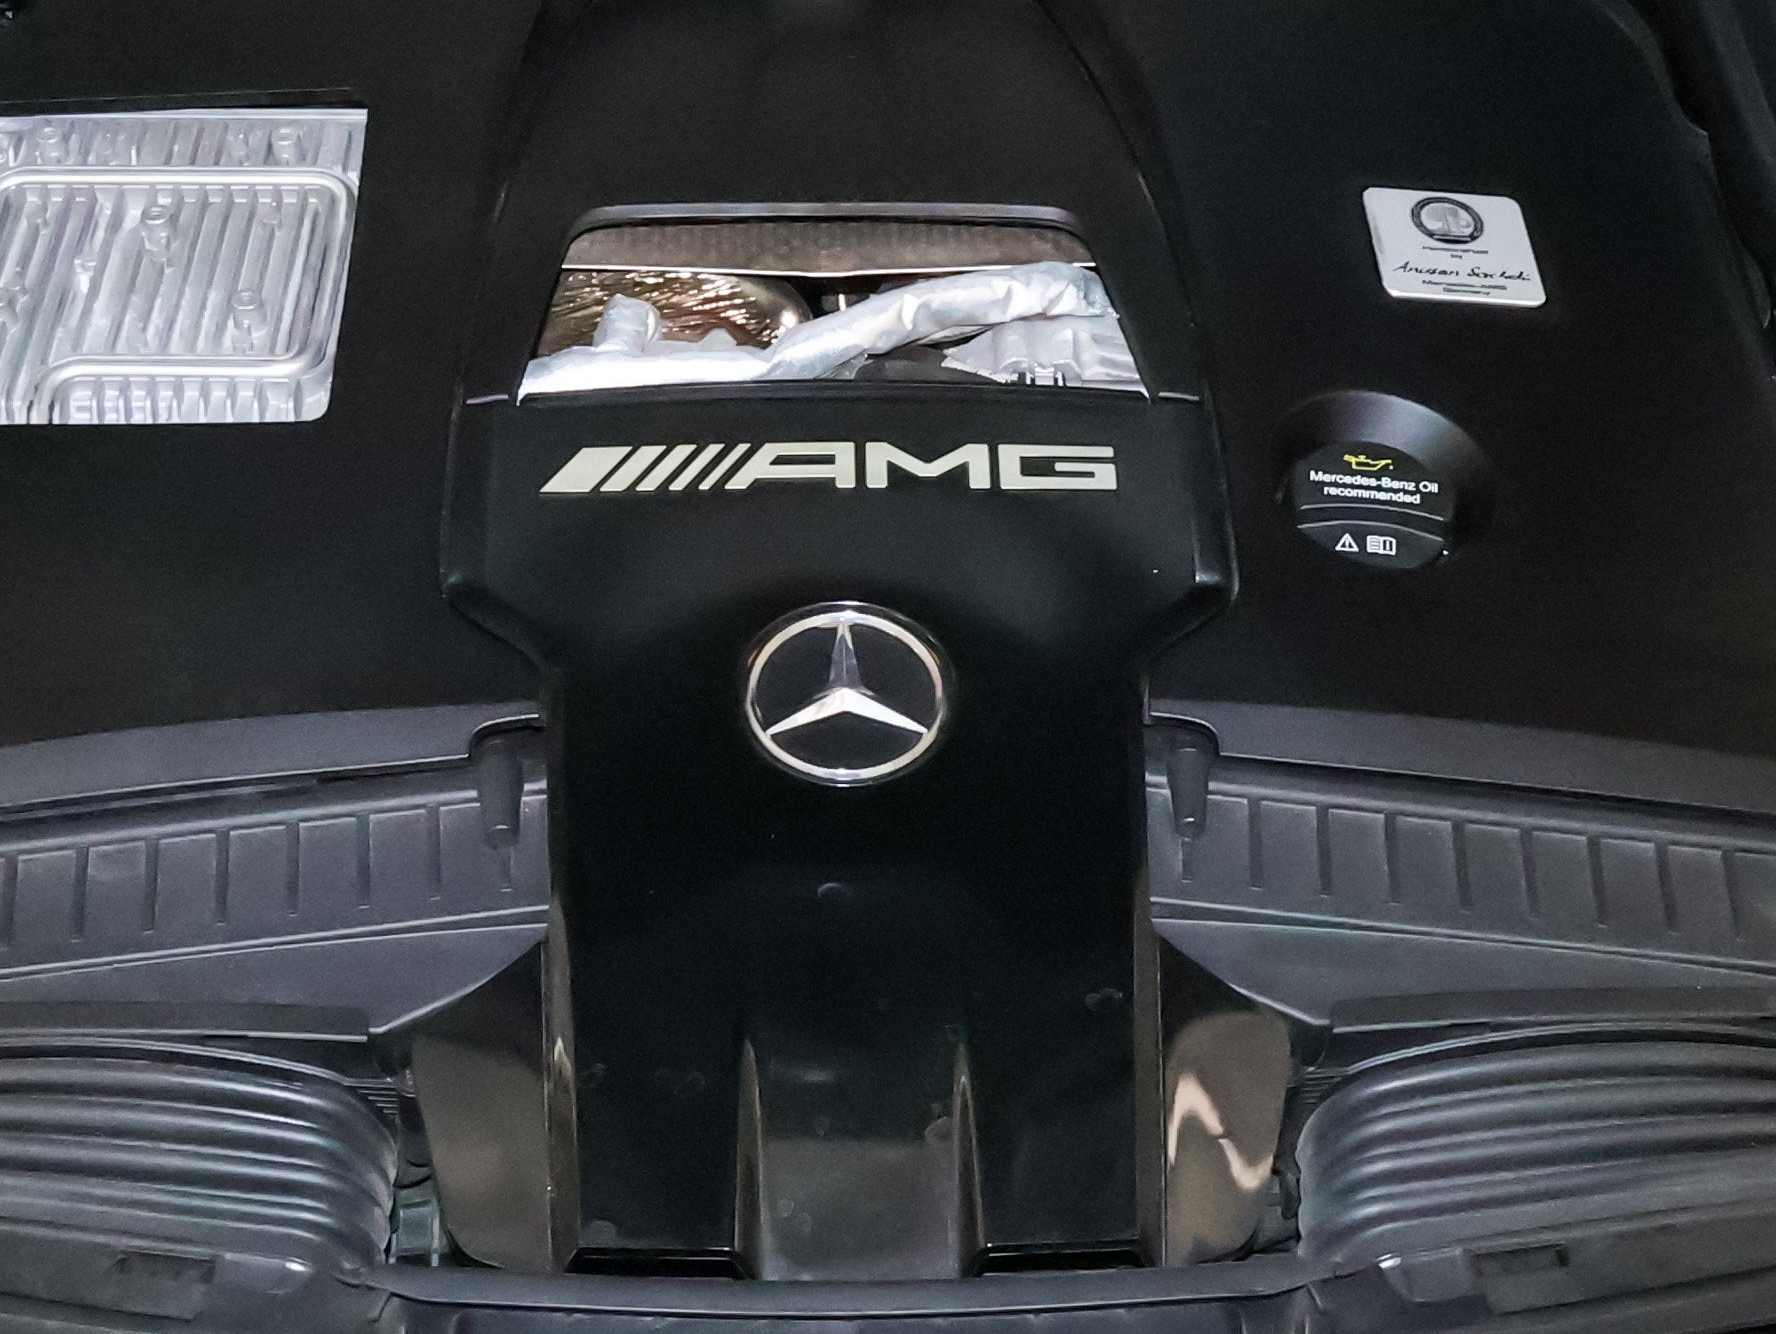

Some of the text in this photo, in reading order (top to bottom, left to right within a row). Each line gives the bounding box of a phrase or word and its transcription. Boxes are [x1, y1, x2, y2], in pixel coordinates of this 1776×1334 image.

[725, 441, 1118, 490] AMG
[1309, 470, 1439, 493] Mercedes-Benz Oil
[1323, 486, 1421, 504] recommended
